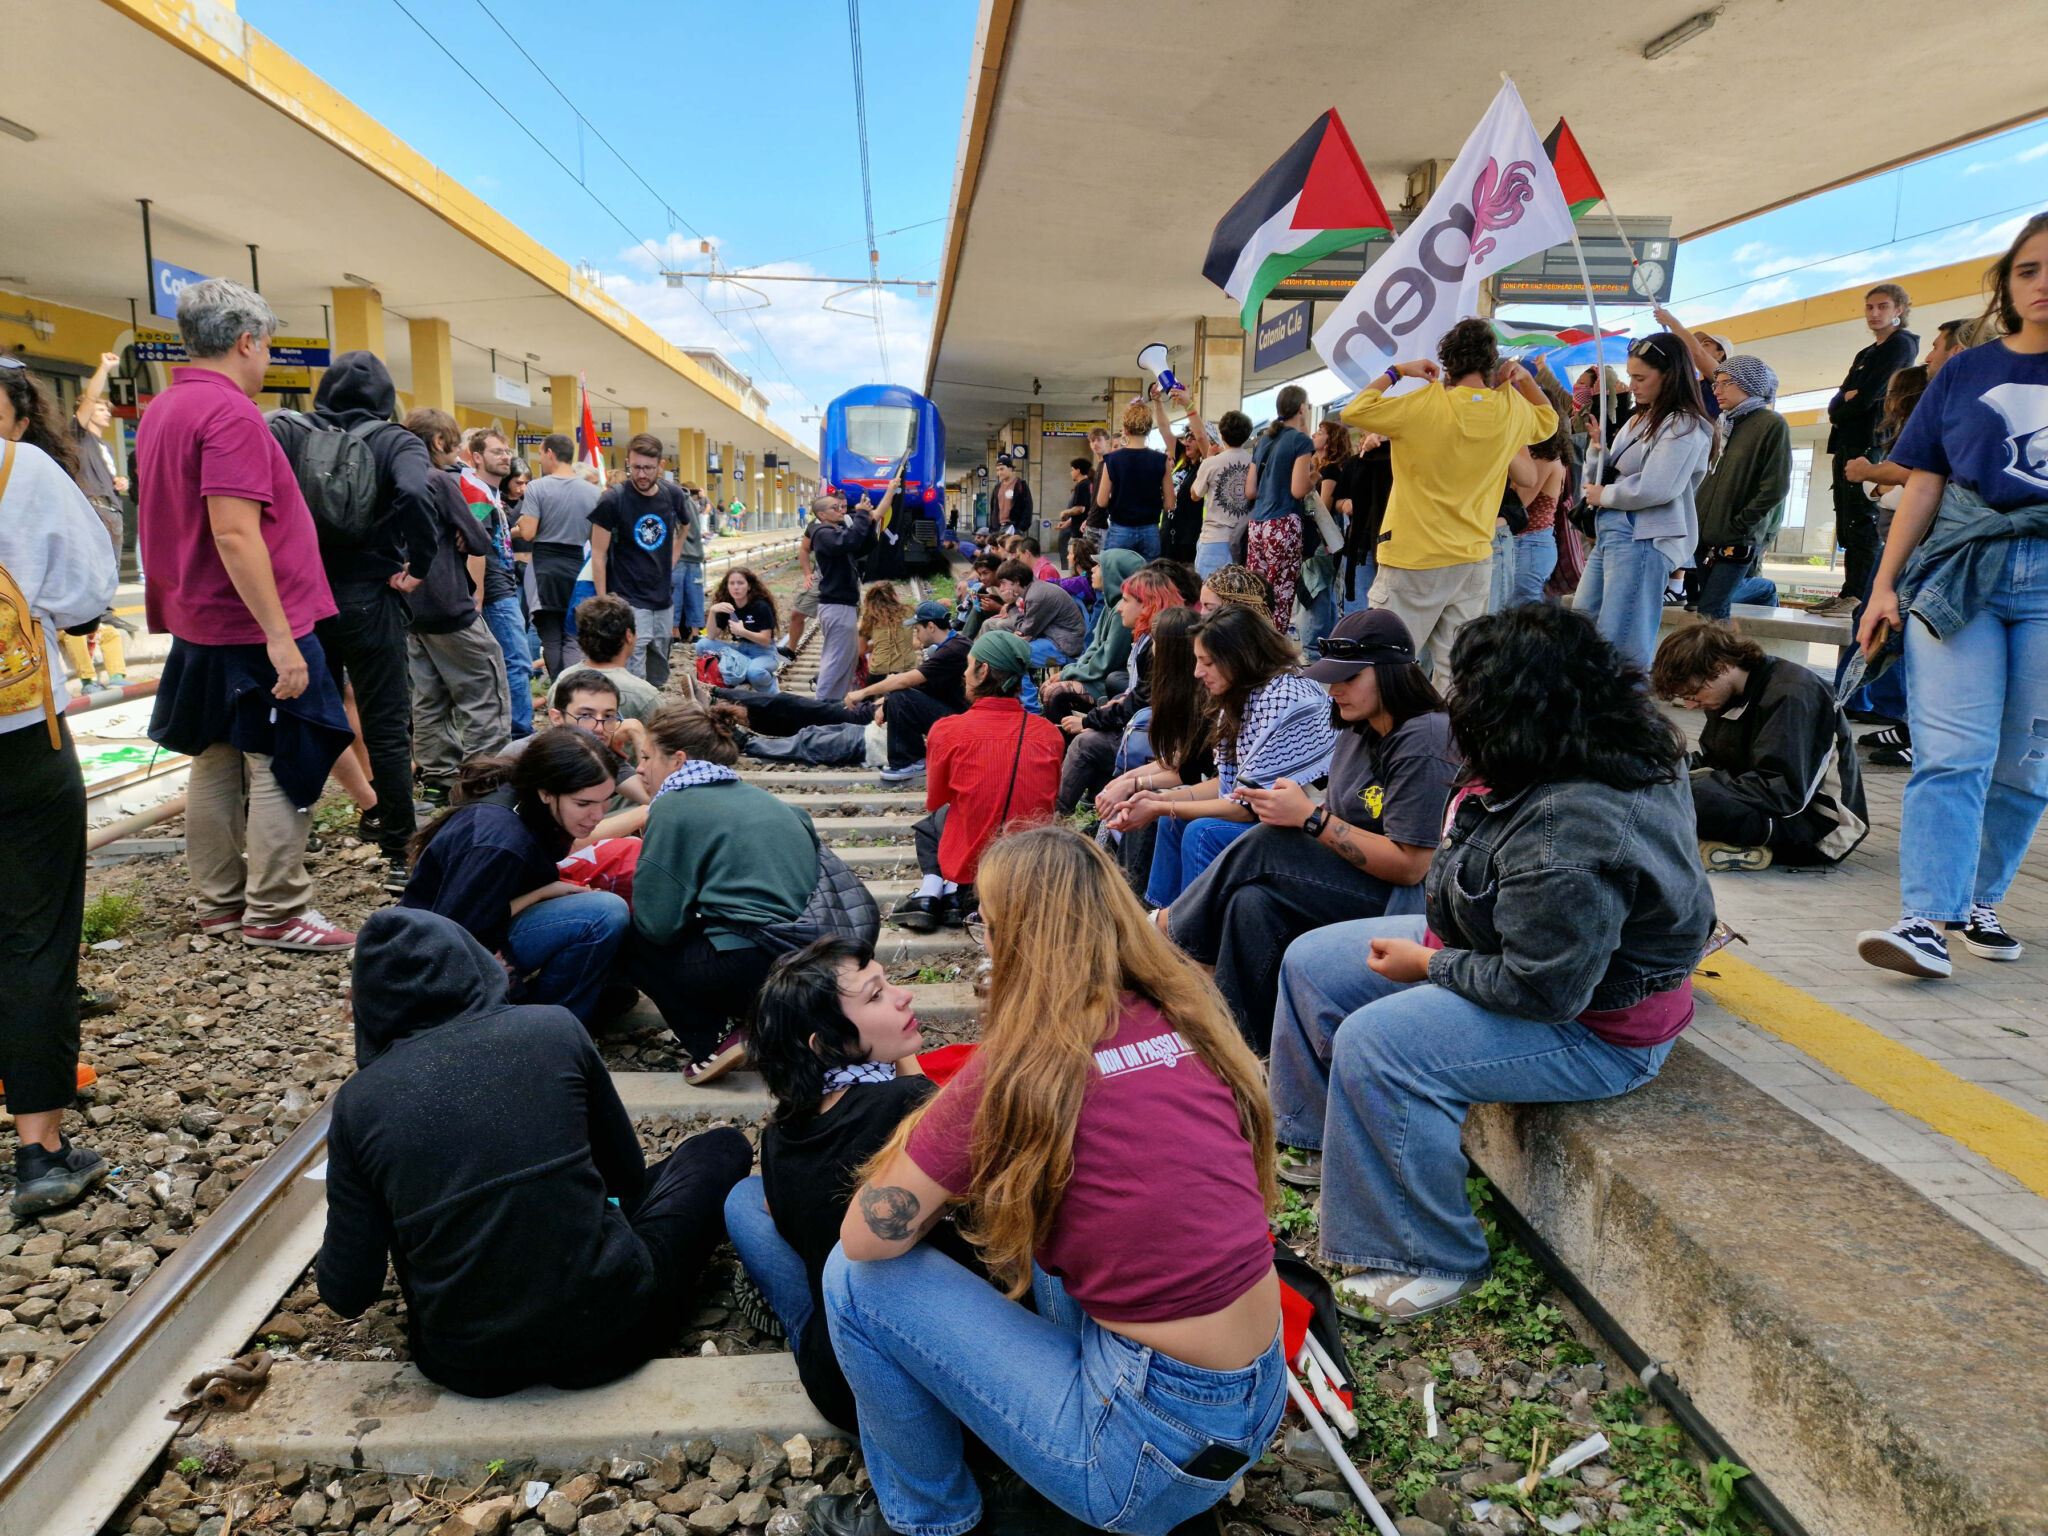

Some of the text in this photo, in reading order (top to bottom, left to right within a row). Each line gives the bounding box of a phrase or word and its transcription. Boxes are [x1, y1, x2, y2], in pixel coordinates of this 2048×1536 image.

[1258, 309, 1303, 351] Catania C.le
[1094, 1048, 1125, 1075] NON
[1118, 1043, 1143, 1068] UN
[1135, 1033, 1179, 1063] PASSO
